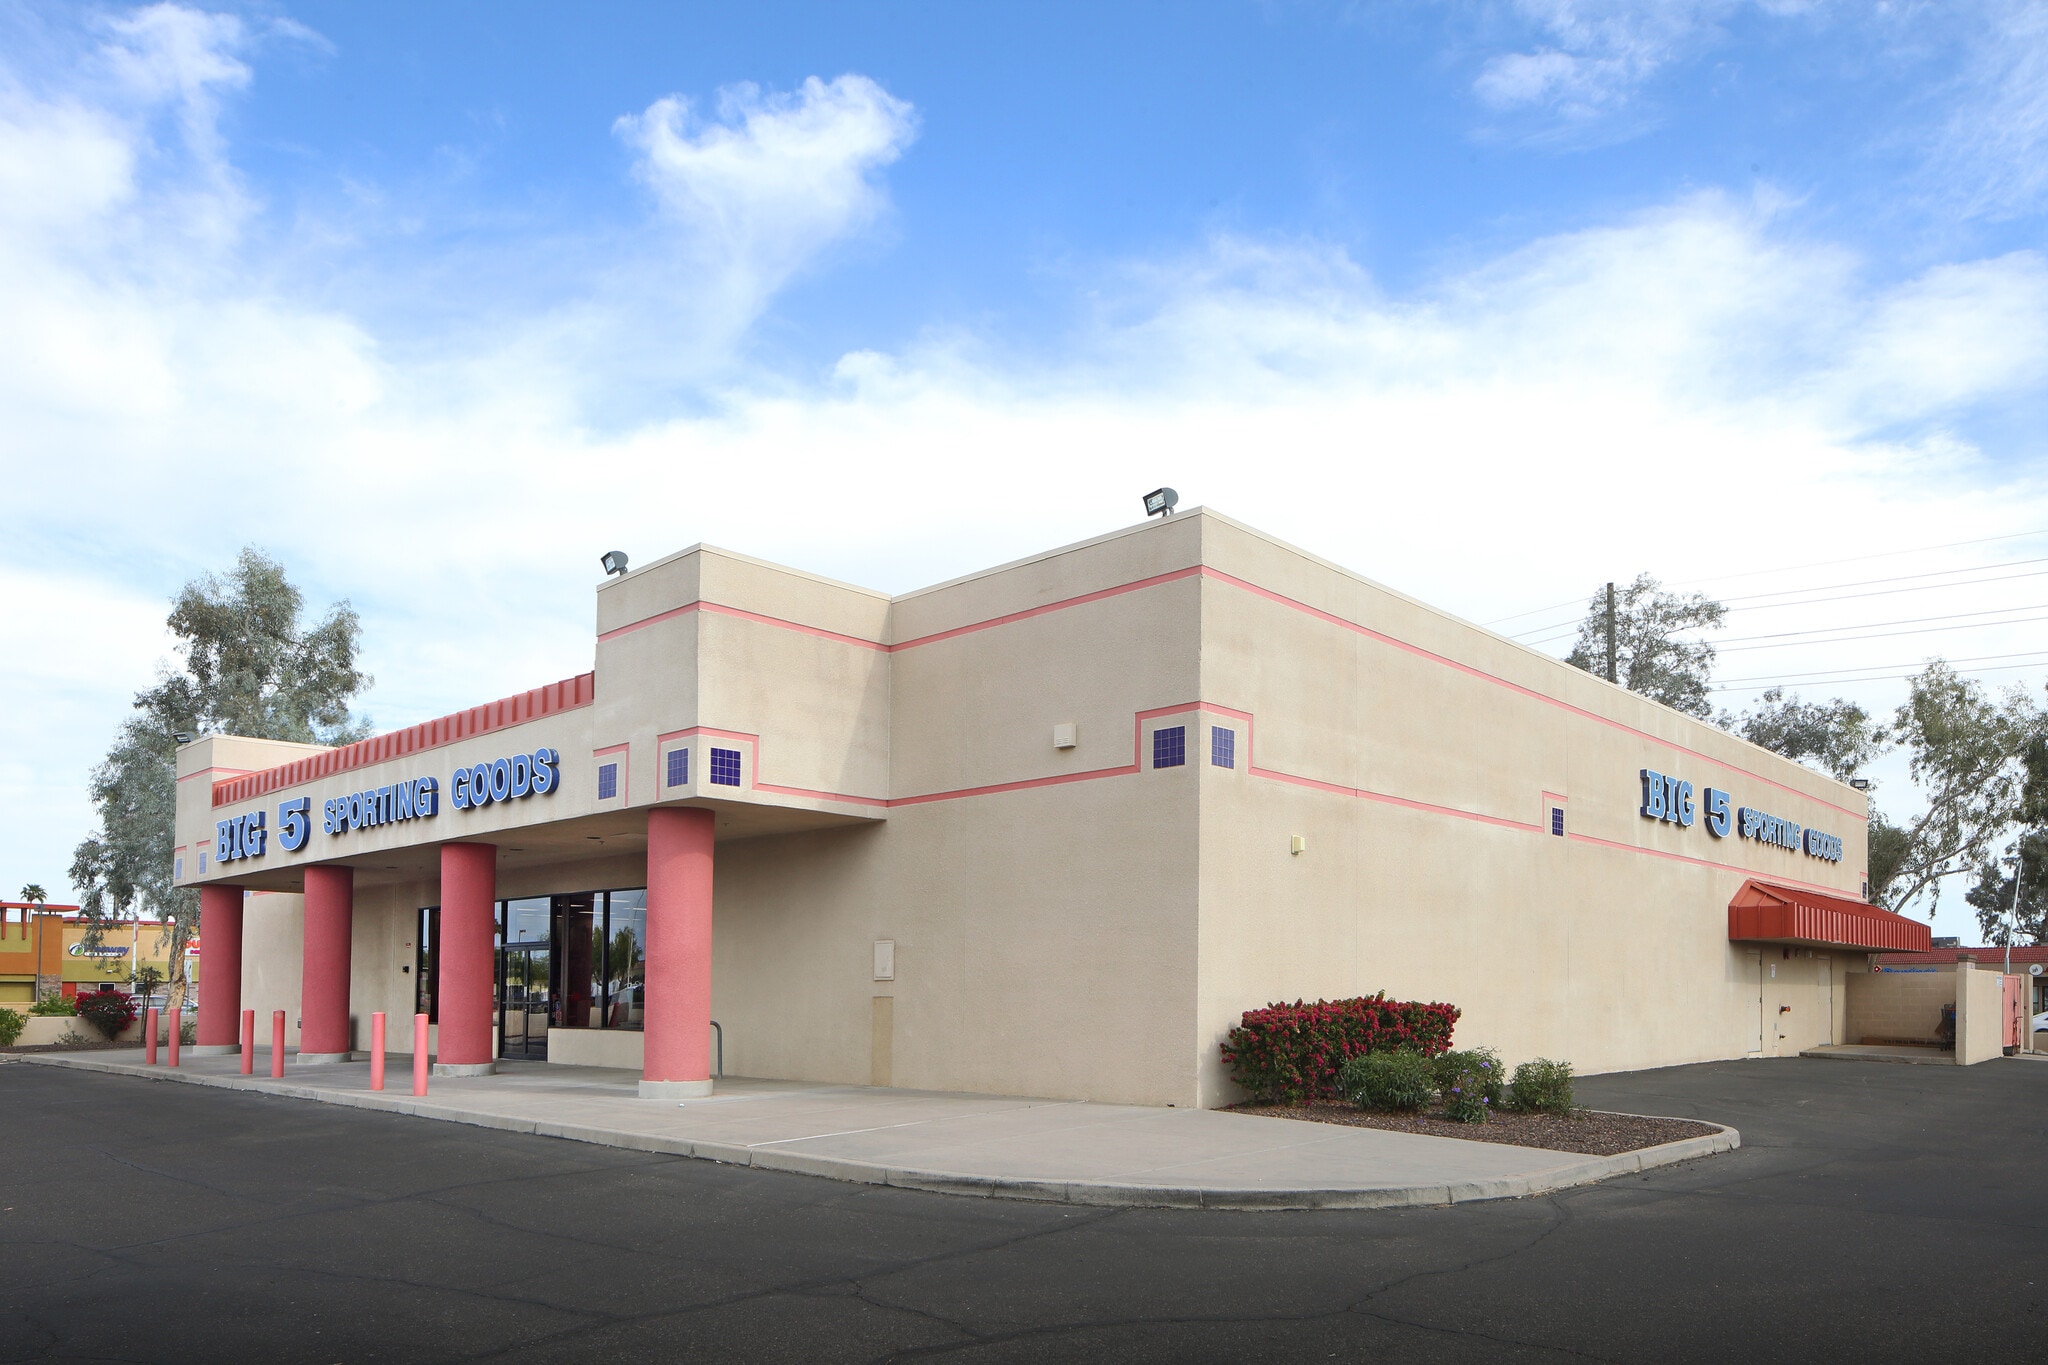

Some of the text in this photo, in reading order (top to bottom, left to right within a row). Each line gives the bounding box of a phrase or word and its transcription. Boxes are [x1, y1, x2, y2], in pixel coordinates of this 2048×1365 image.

[215, 747, 559, 862] BIG 5 SPORTING GOODS
[1640, 769, 1842, 863] BIG 5 SPORTING GOODS
